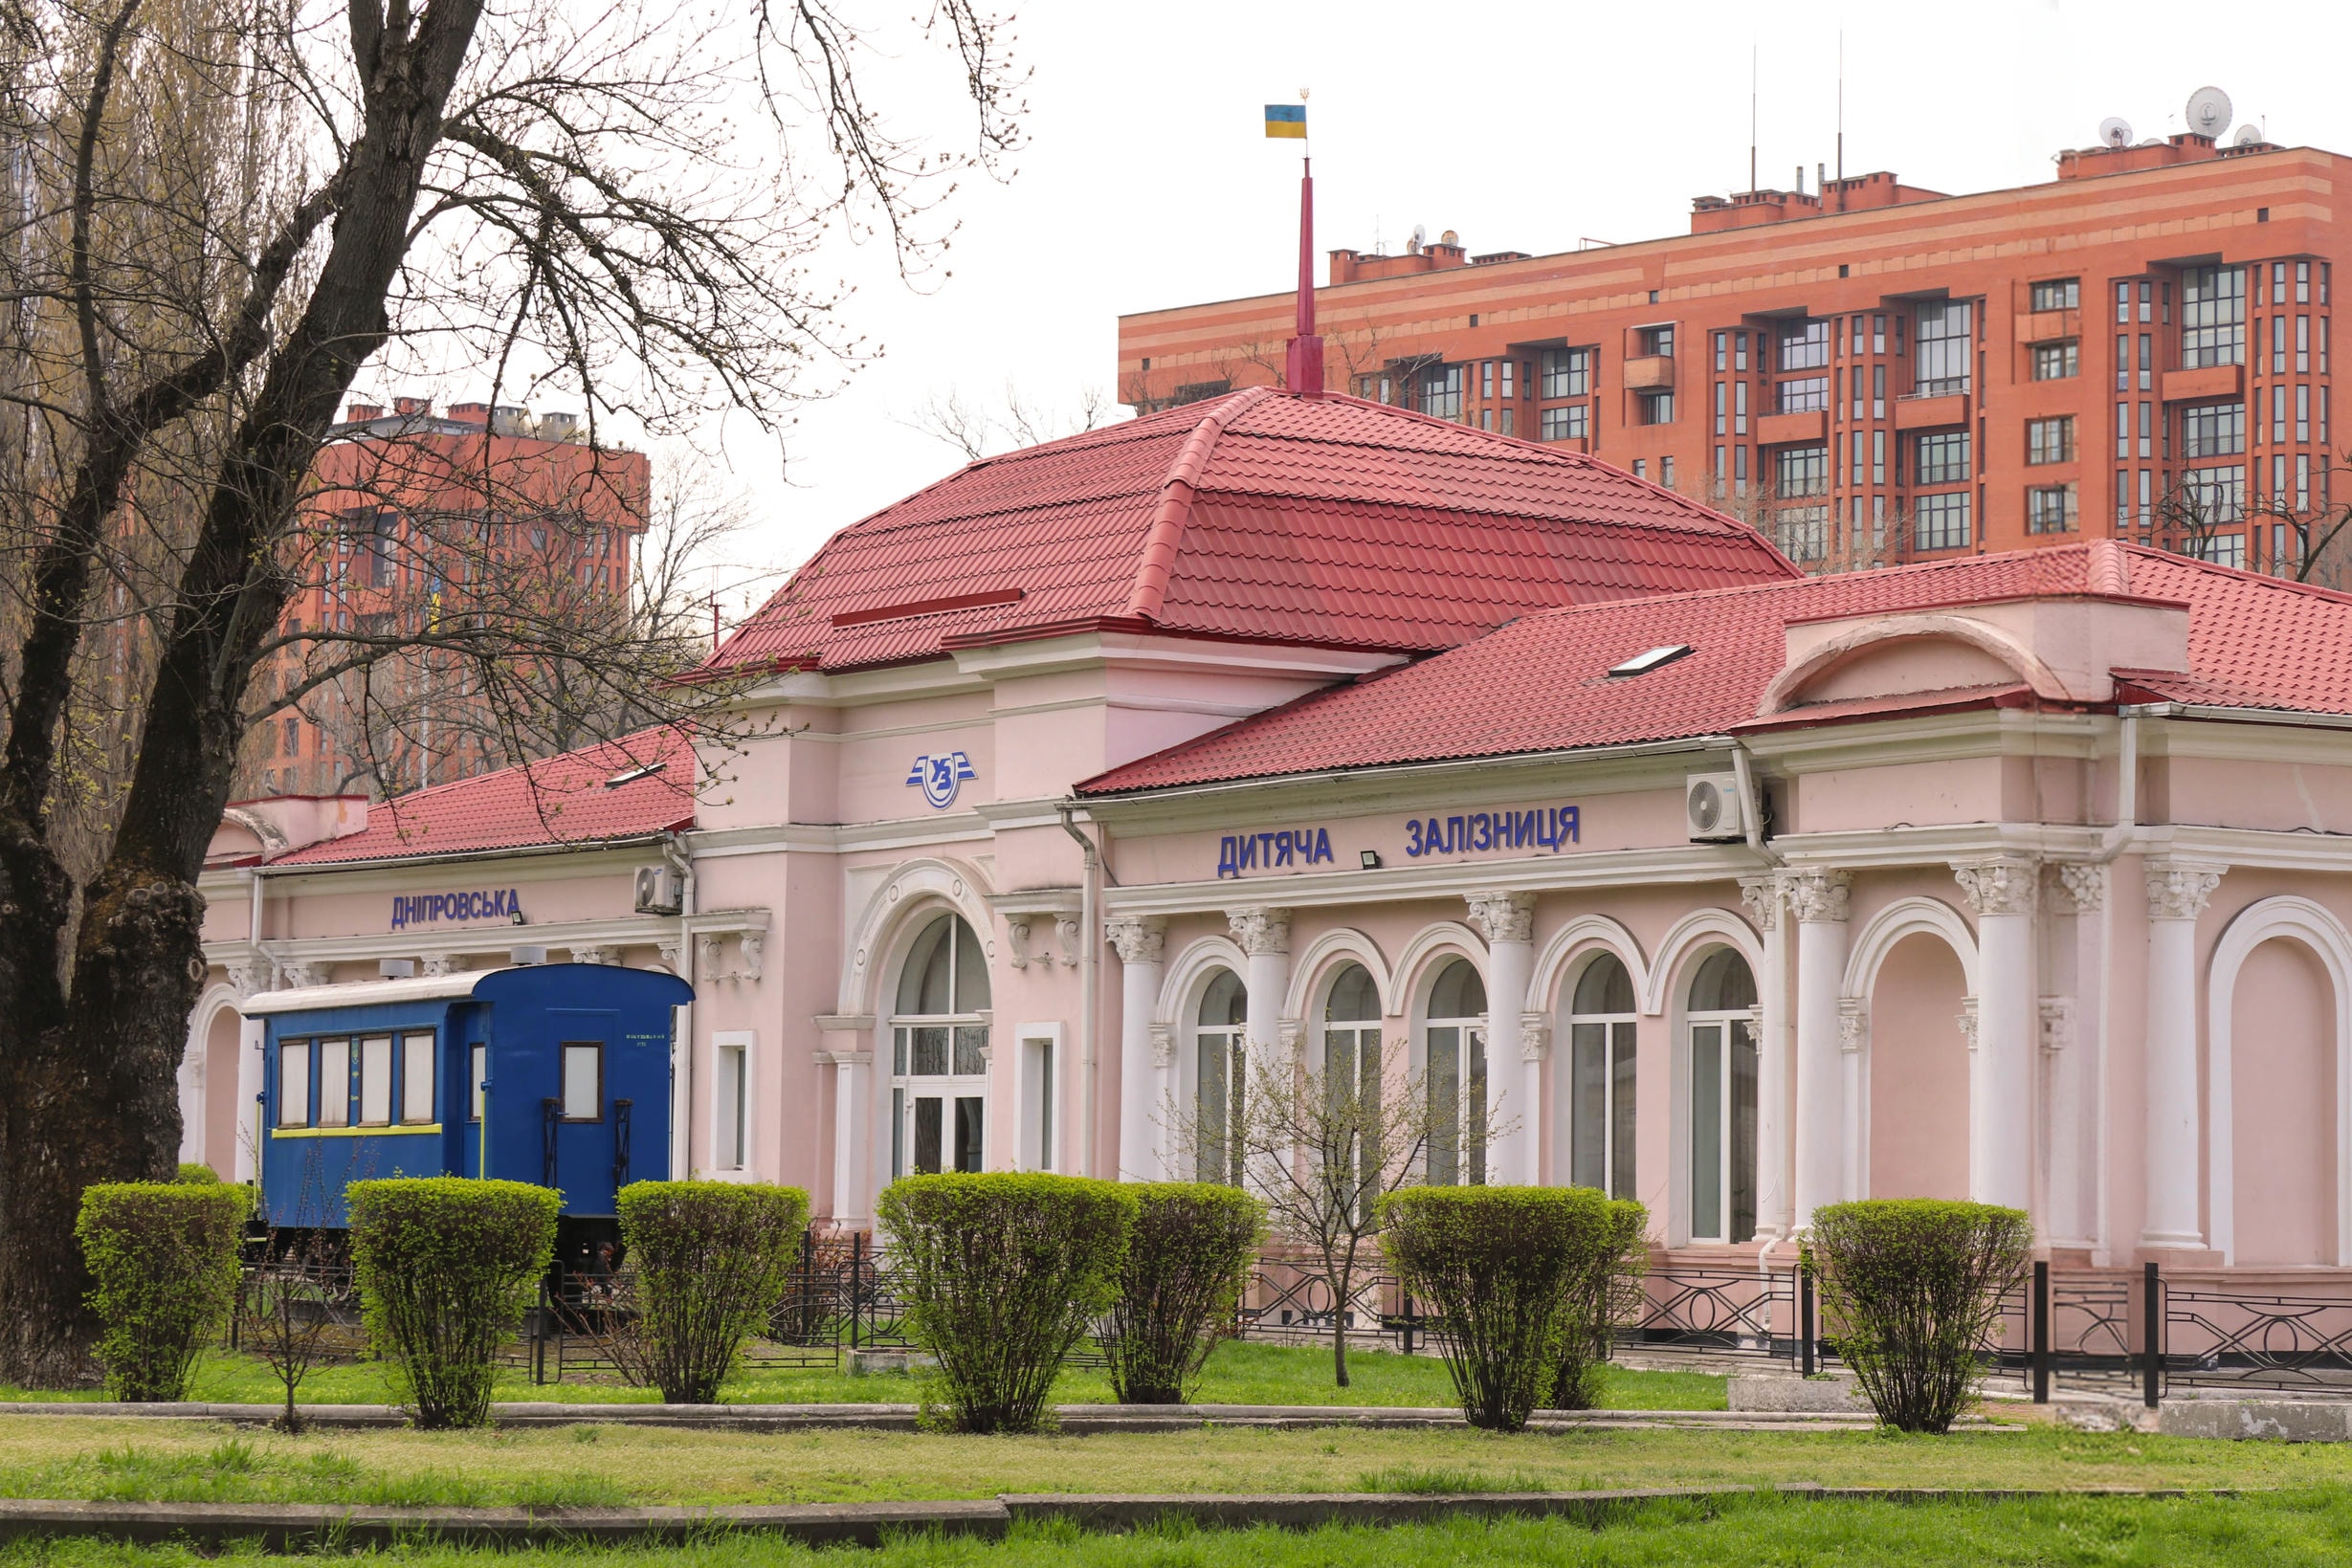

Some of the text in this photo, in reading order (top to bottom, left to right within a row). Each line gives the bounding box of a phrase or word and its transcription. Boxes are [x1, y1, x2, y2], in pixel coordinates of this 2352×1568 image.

[1217, 806, 1580, 878] ДИТЯЧА ЗАЛІЗНИЦЯ
[391, 889, 520, 930] ДНІПРОВСЬКА
